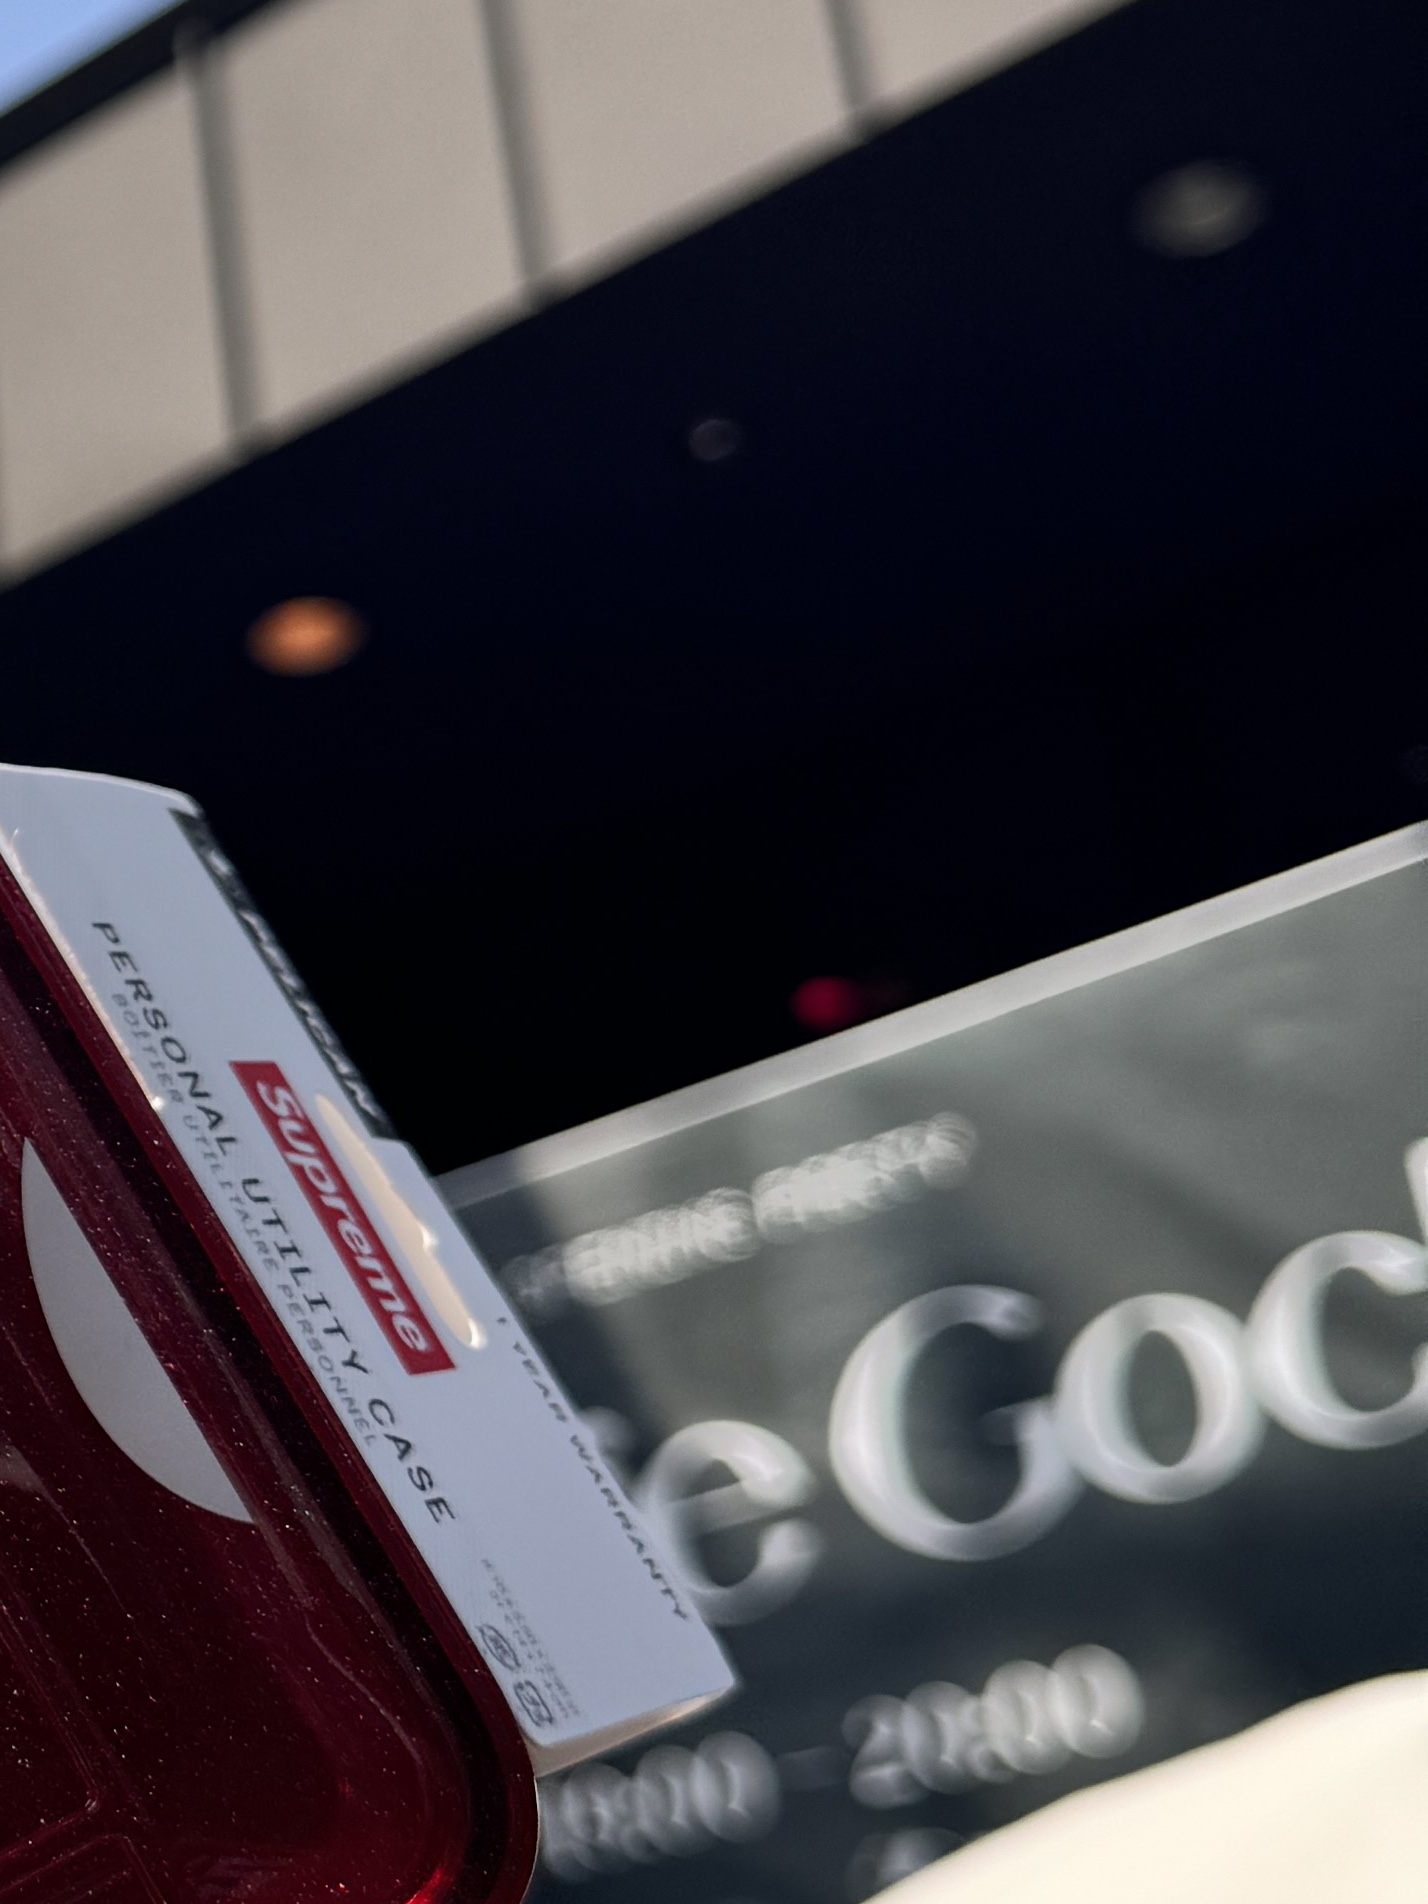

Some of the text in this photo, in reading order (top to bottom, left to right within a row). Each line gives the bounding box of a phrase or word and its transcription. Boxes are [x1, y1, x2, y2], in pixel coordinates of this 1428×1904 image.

[92, 922, 455, 1525] PERSONAL UTILITY CASE
[182, 1114, 280, 1274] UTILITAIRE
[278, 1283, 376, 1449] PERSONNEL
[257, 1080, 428, 1352] Supreme
[569, 1434, 691, 1622] WARRANTY
